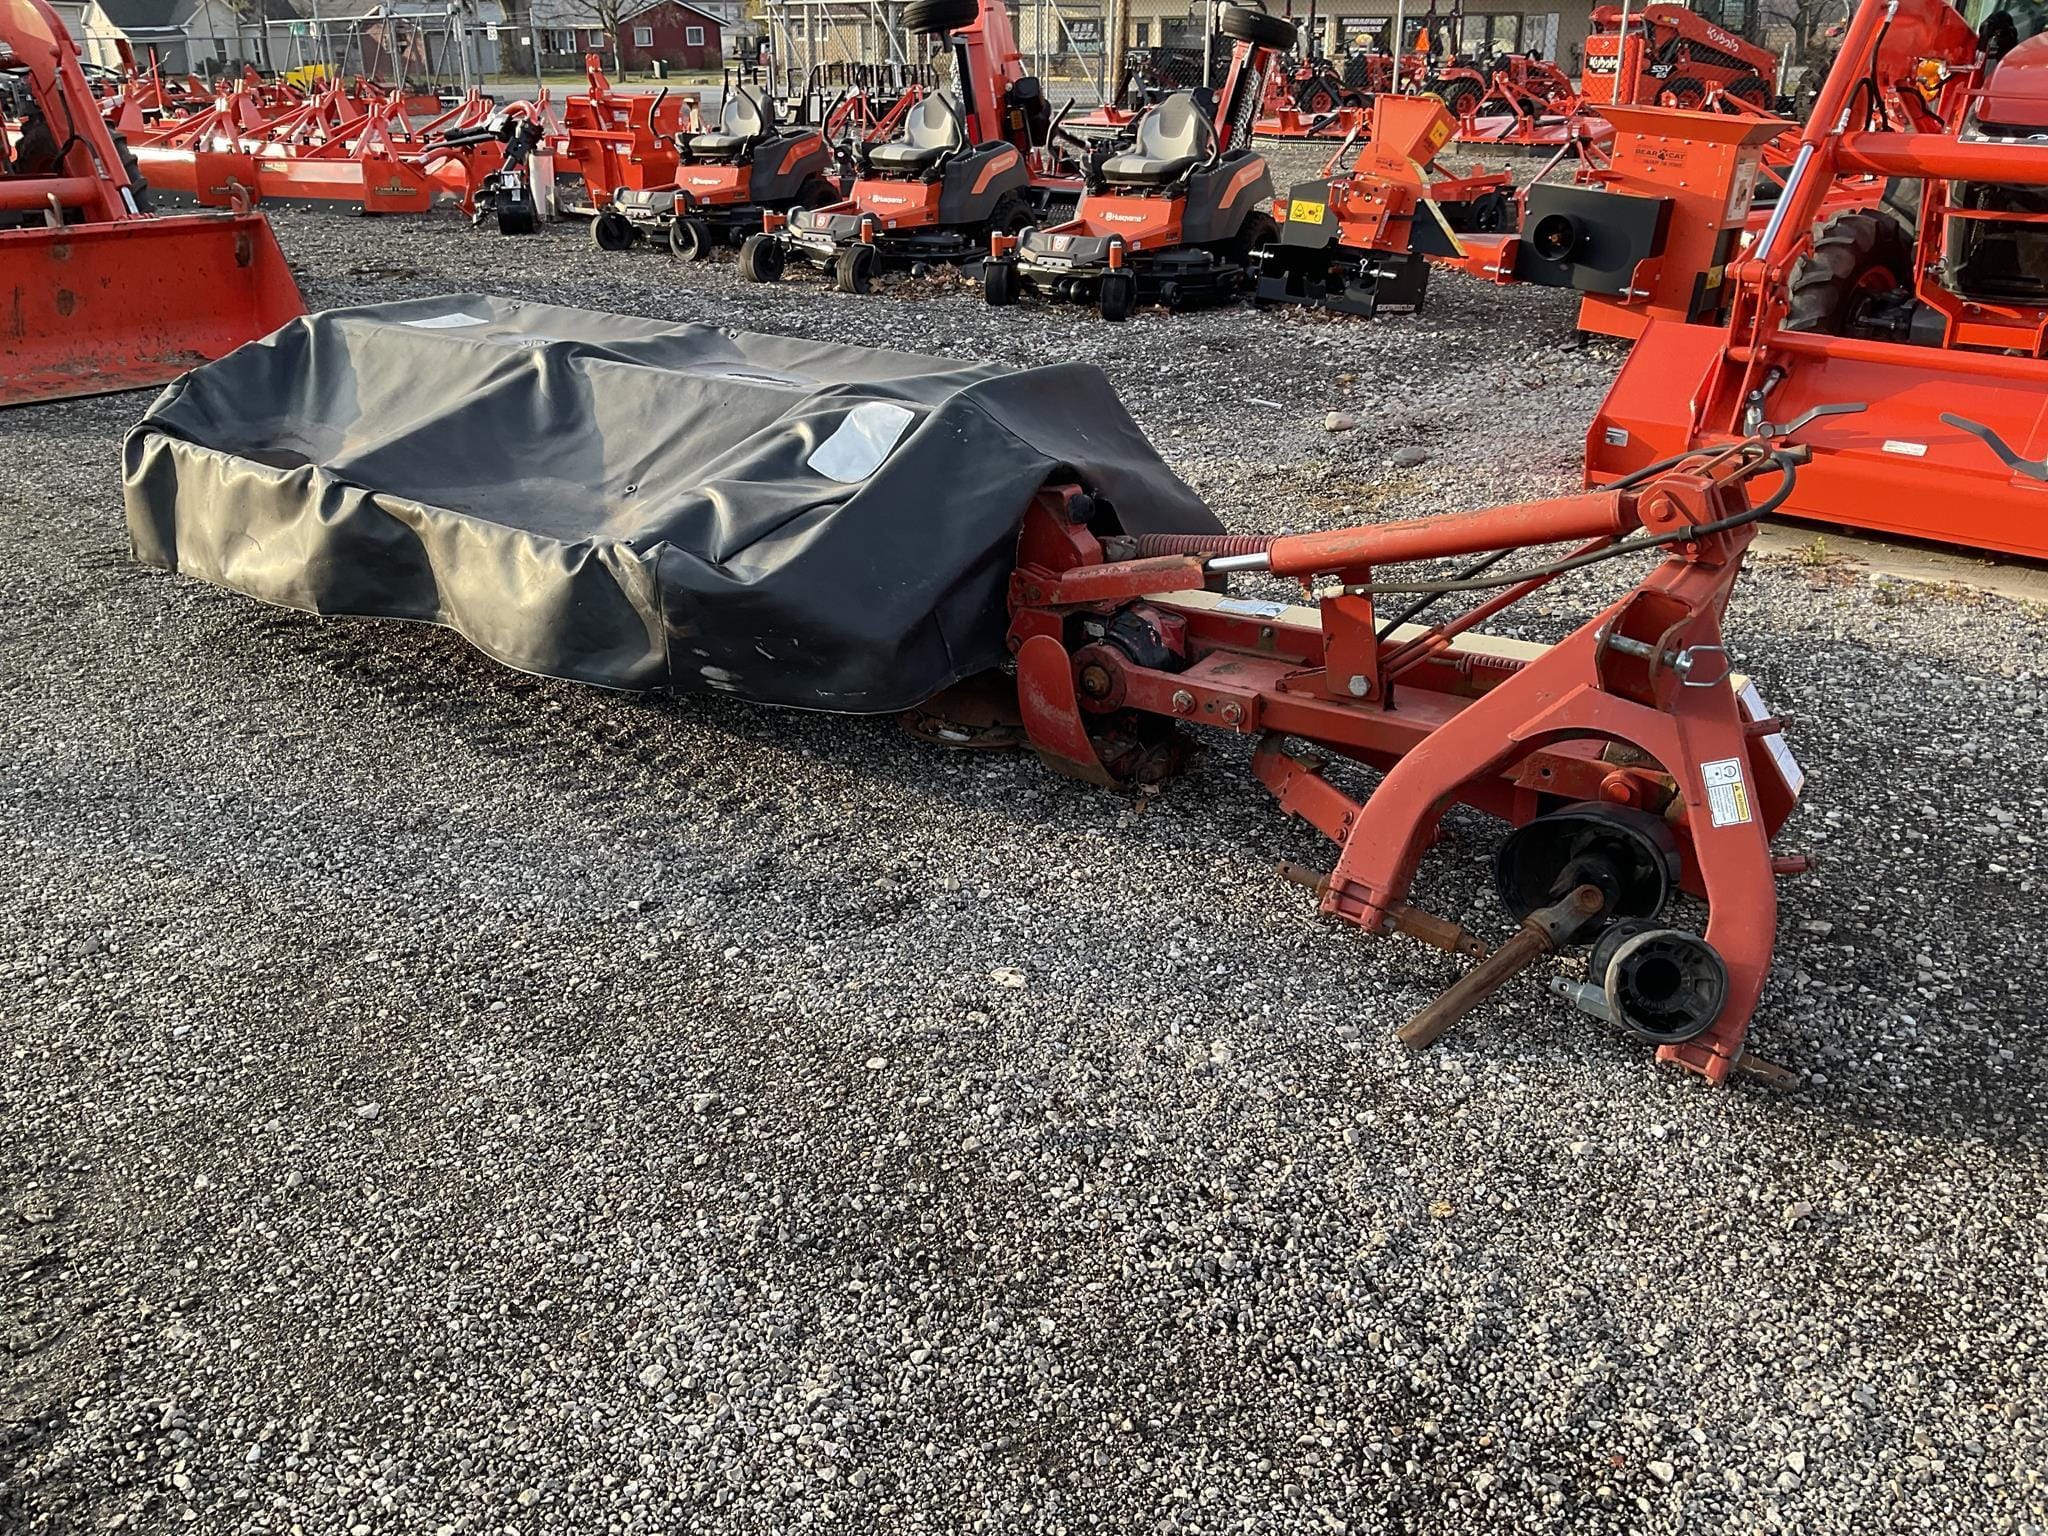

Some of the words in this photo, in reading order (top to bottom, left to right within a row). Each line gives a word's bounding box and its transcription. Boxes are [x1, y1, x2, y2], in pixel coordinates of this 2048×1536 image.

[1069, 32, 1098, 40] PIZZA
[1706, 26, 1740, 52] Kubota
[1651, 64, 1673, 73] SSV
[1635, 148, 1658, 156] BEAR
[1668, 152, 1687, 160] CAT
[1111, 212, 1142, 223] Husqvarna
